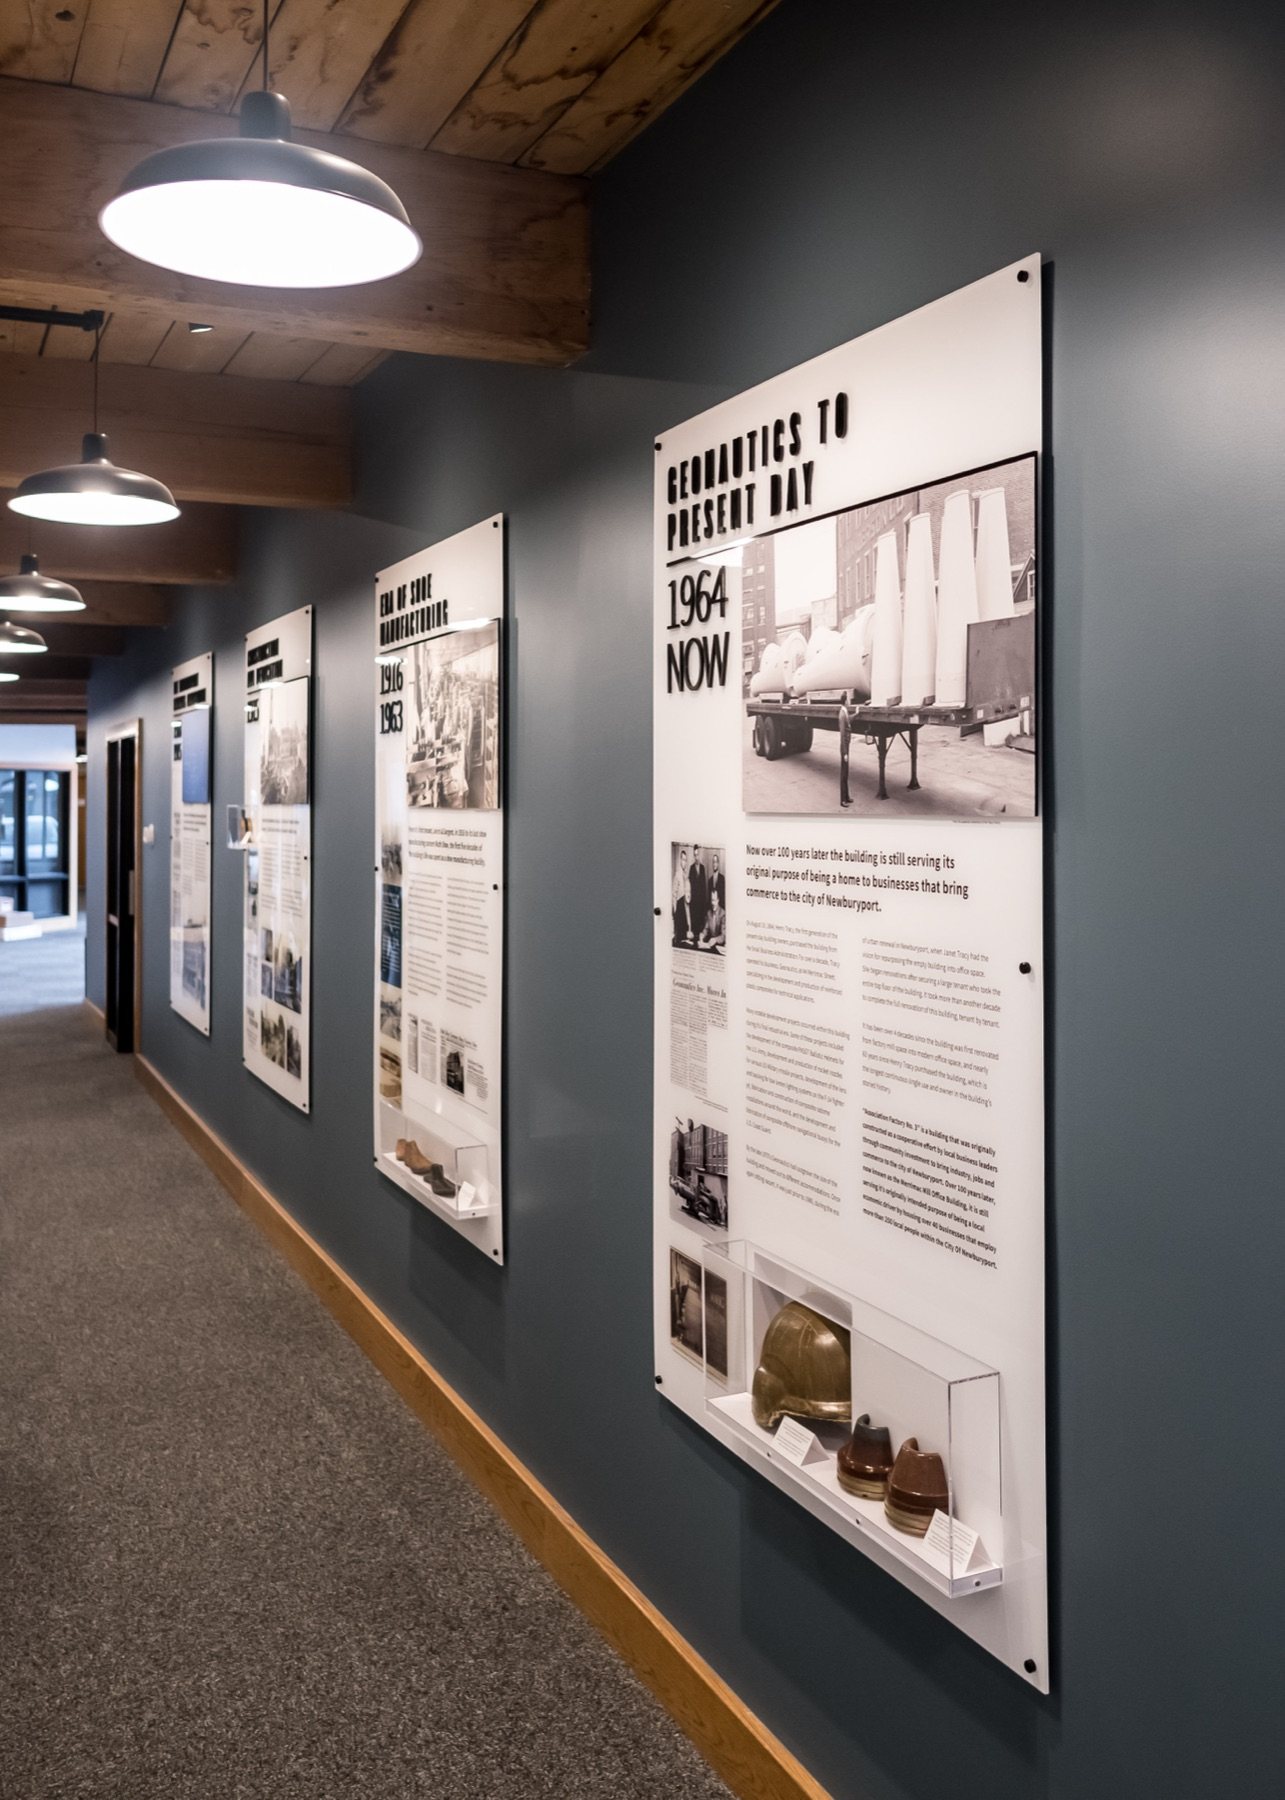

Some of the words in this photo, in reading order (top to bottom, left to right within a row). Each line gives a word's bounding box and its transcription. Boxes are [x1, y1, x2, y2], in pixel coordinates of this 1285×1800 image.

[668, 412, 801, 504] GEONAUTICS
[817, 392, 849, 444] TO
[667, 483, 756, 551] PRESENT
[770, 460, 815, 517] DAY
[380, 590, 394, 618] ERA
[397, 584, 407, 611] OF
[410, 573, 432, 605] SHOE
[667, 566, 729, 630] 1964
[380, 599, 449, 646] MANUFACTURING
[380, 659, 403, 695] 1916
[667, 632, 730, 694] NOW
[380, 701, 403, 734] 1963
[746, 844, 760, 855] Now
[761, 848, 776, 856] over
[777, 847, 790, 858] 100
[791, 850, 810, 861] years
[811, 848, 829, 860] later
[830, 849, 843, 861] the
[845, 850, 878, 867] building
[880, 851, 887, 864] is
[888, 852, 905, 865] still
[907, 853, 941, 871] serving
[943, 854, 955, 869] its
[746, 865, 771, 880] original
[772, 869, 800, 881] purpose
[801, 869, 809, 881] of
[810, 870, 831, 886] being
[838, 872, 860, 886] home
[862, 875, 871, 887] to
[872, 875, 919, 891] businesses
[921, 879, 940, 893] that
[943, 880, 969, 900] bring
[746, 888, 779, 900] commerce
[780, 891, 788, 901] to
[789, 890, 800, 902] the
[802, 891, 816, 907] city
[817, 893, 825, 905] of
[826, 895, 882, 912] Newburyport.
[922, 1143, 936, 1152] effort
[944, 1148, 955, 1159] local
[956, 1153, 978, 1166] business
[979, 1160, 998, 1173] leaders
[929, 1129, 948, 1143] building
[949, 1136, 959, 1144] that
[960, 1140, 970, 1148] was
[971, 1144, 996, 1157] originally
[889, 1160, 897, 1168] the
[945, 1180, 956, 1190] Over
[966, 1189, 980, 1199] years
[936, 1162, 949, 1174] bring
[972, 1174, 983, 1184] jobs
[984, 1180, 995, 1188] and
[927, 1205, 947, 1217] purpose
[953, 1213, 967, 1227] being
[972, 1221, 985, 1232] local
[932, 1190, 945, 1201] Office
[979, 1209, 989, 1218] still
[904, 1226, 919, 1236] people
[920, 1232, 935, 1243] within
[944, 1241, 954, 1252] City
[962, 1248, 997, 1269] Newburyport.
[939, 1224, 965, 1240] businesses
[965, 1235, 976, 1245] that
[977, 1241, 996, 1254] employ
